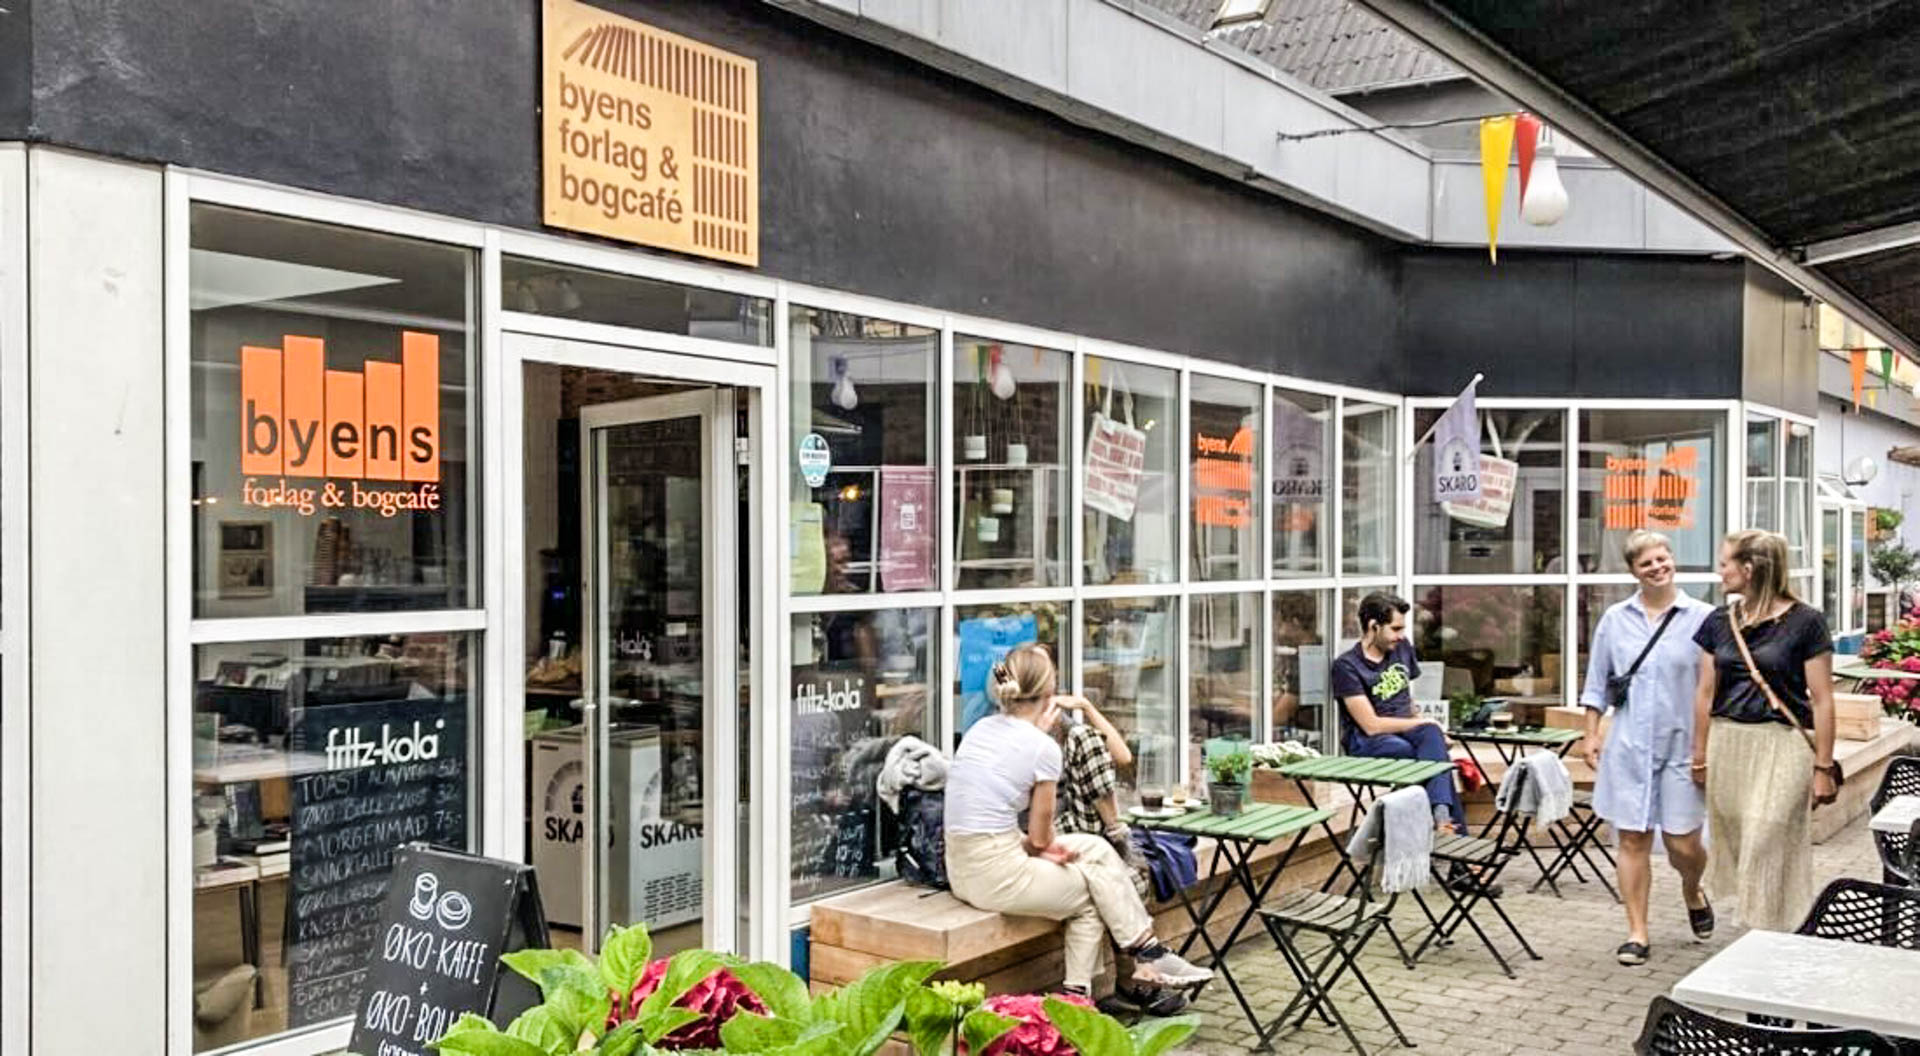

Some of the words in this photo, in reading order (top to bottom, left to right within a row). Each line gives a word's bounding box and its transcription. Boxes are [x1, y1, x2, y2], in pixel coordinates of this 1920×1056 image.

[559, 71, 652, 130] byens
[559, 118, 647, 182] forlag
[659, 145, 679, 181] &
[560, 163, 683, 224] bogcafé
[247, 399, 434, 467] byens
[243, 478, 315, 516] forlag
[321, 482, 345, 507] &
[352, 482, 440, 517] bogcafé
[797, 678, 863, 714] fritz-kola
[325, 719, 445, 770] fritz-kola
[296, 770, 361, 803] TOAST
[303, 815, 428, 858] MORGENMAD
[545, 817, 584, 843] SKA
[384, 923, 488, 984] ØKO-KAFFE
